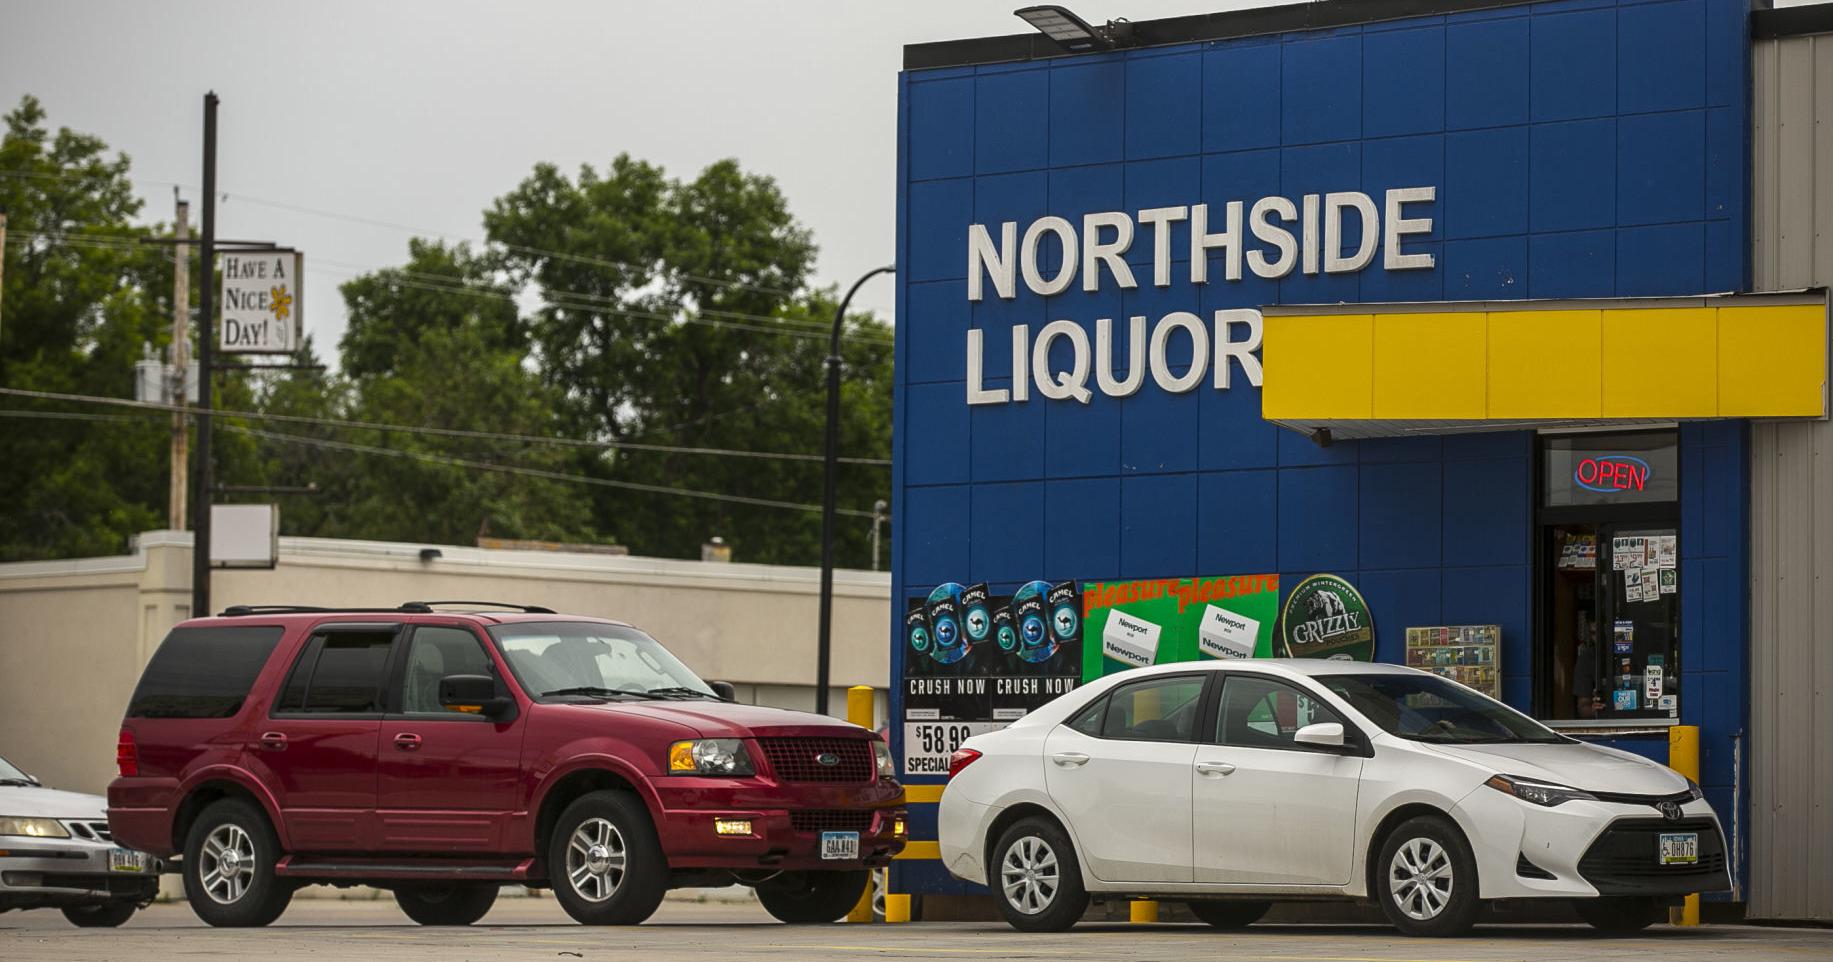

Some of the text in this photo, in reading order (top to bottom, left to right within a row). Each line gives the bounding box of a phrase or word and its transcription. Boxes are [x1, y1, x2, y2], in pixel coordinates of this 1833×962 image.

[967, 186, 1436, 301] NORTHSIDE
[226, 258, 285, 279] HAVE A
[225, 287, 267, 310] NICE
[224, 319, 268, 346] DAY!
[966, 308, 1263, 405] LIQUOR
[1577, 459, 1645, 491] OPEN
[962, 590, 986, 605] CAMEL
[1050, 588, 1074, 603] CAMEL
[1083, 579, 1179, 618] pleasure
[1177, 574, 1280, 615] pleasure
[931, 602, 954, 617] CAMEL
[993, 611, 1011, 624] CAMEL
[1018, 601, 1041, 615] CAMEL
[907, 612, 925, 625] CAMEL
[1118, 618, 1148, 635] Newport
[1215, 613, 1246, 631] Newport
[1293, 611, 1361, 643] GRIZZLY
[1106, 641, 1149, 665] Newport
[1202, 637, 1247, 660] Newport
[910, 679, 986, 694] CRUSH NOW
[997, 678, 1075, 694] CRUSH NOW
[908, 757, 950, 772] SPECIAL
